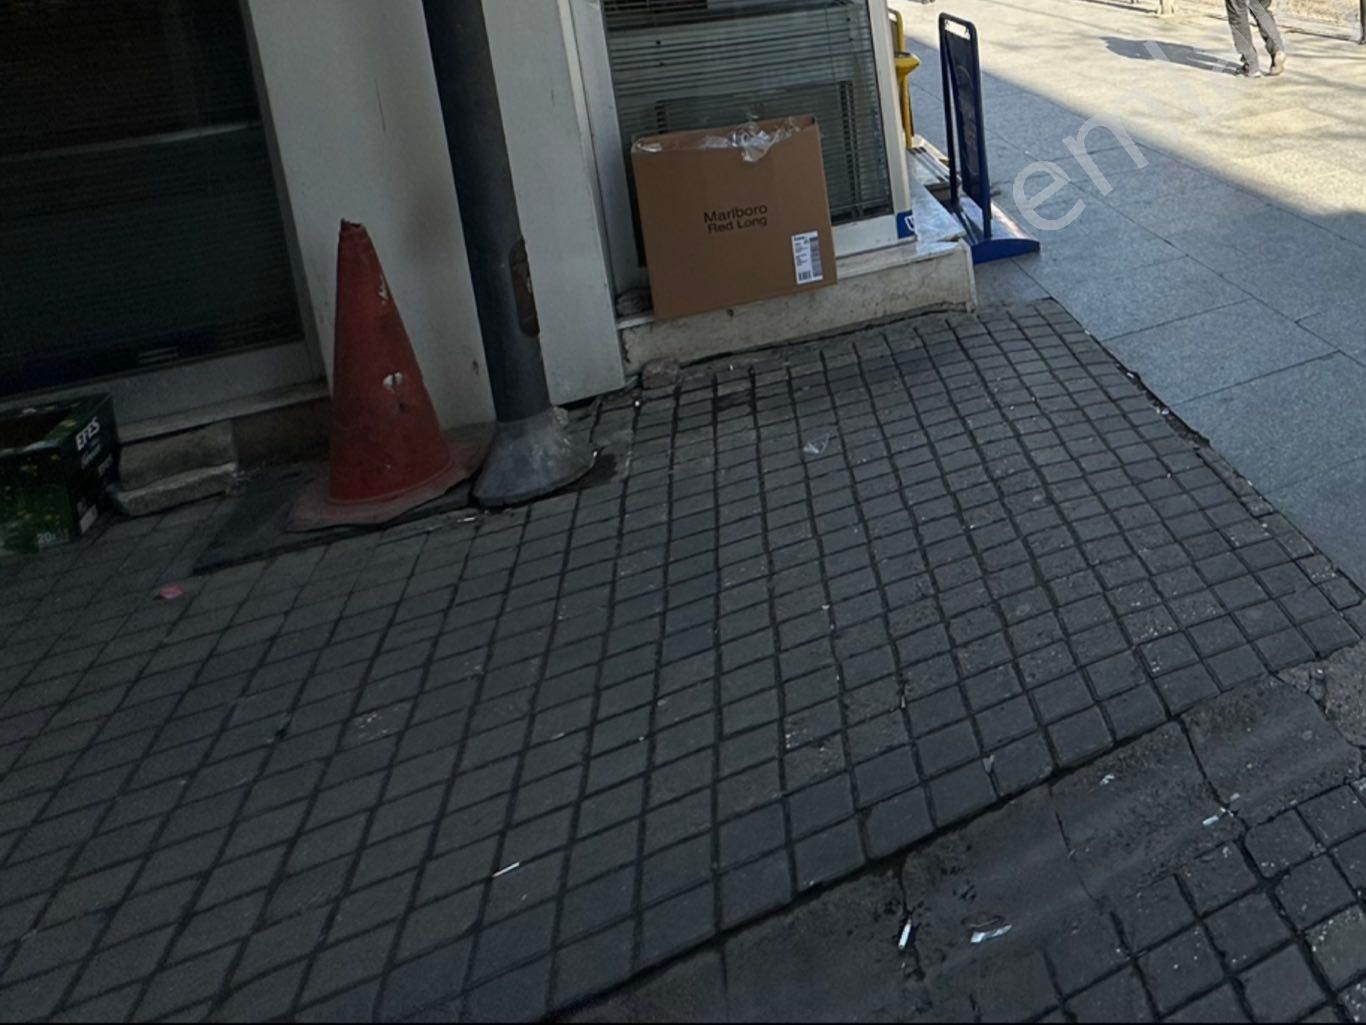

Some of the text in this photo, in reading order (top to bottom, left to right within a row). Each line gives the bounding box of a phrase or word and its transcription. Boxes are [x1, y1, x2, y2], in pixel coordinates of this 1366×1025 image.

[704, 204, 769, 224] Marlboro
[707, 216, 768, 234] Red Long
[75, 416, 101, 451] EFES
